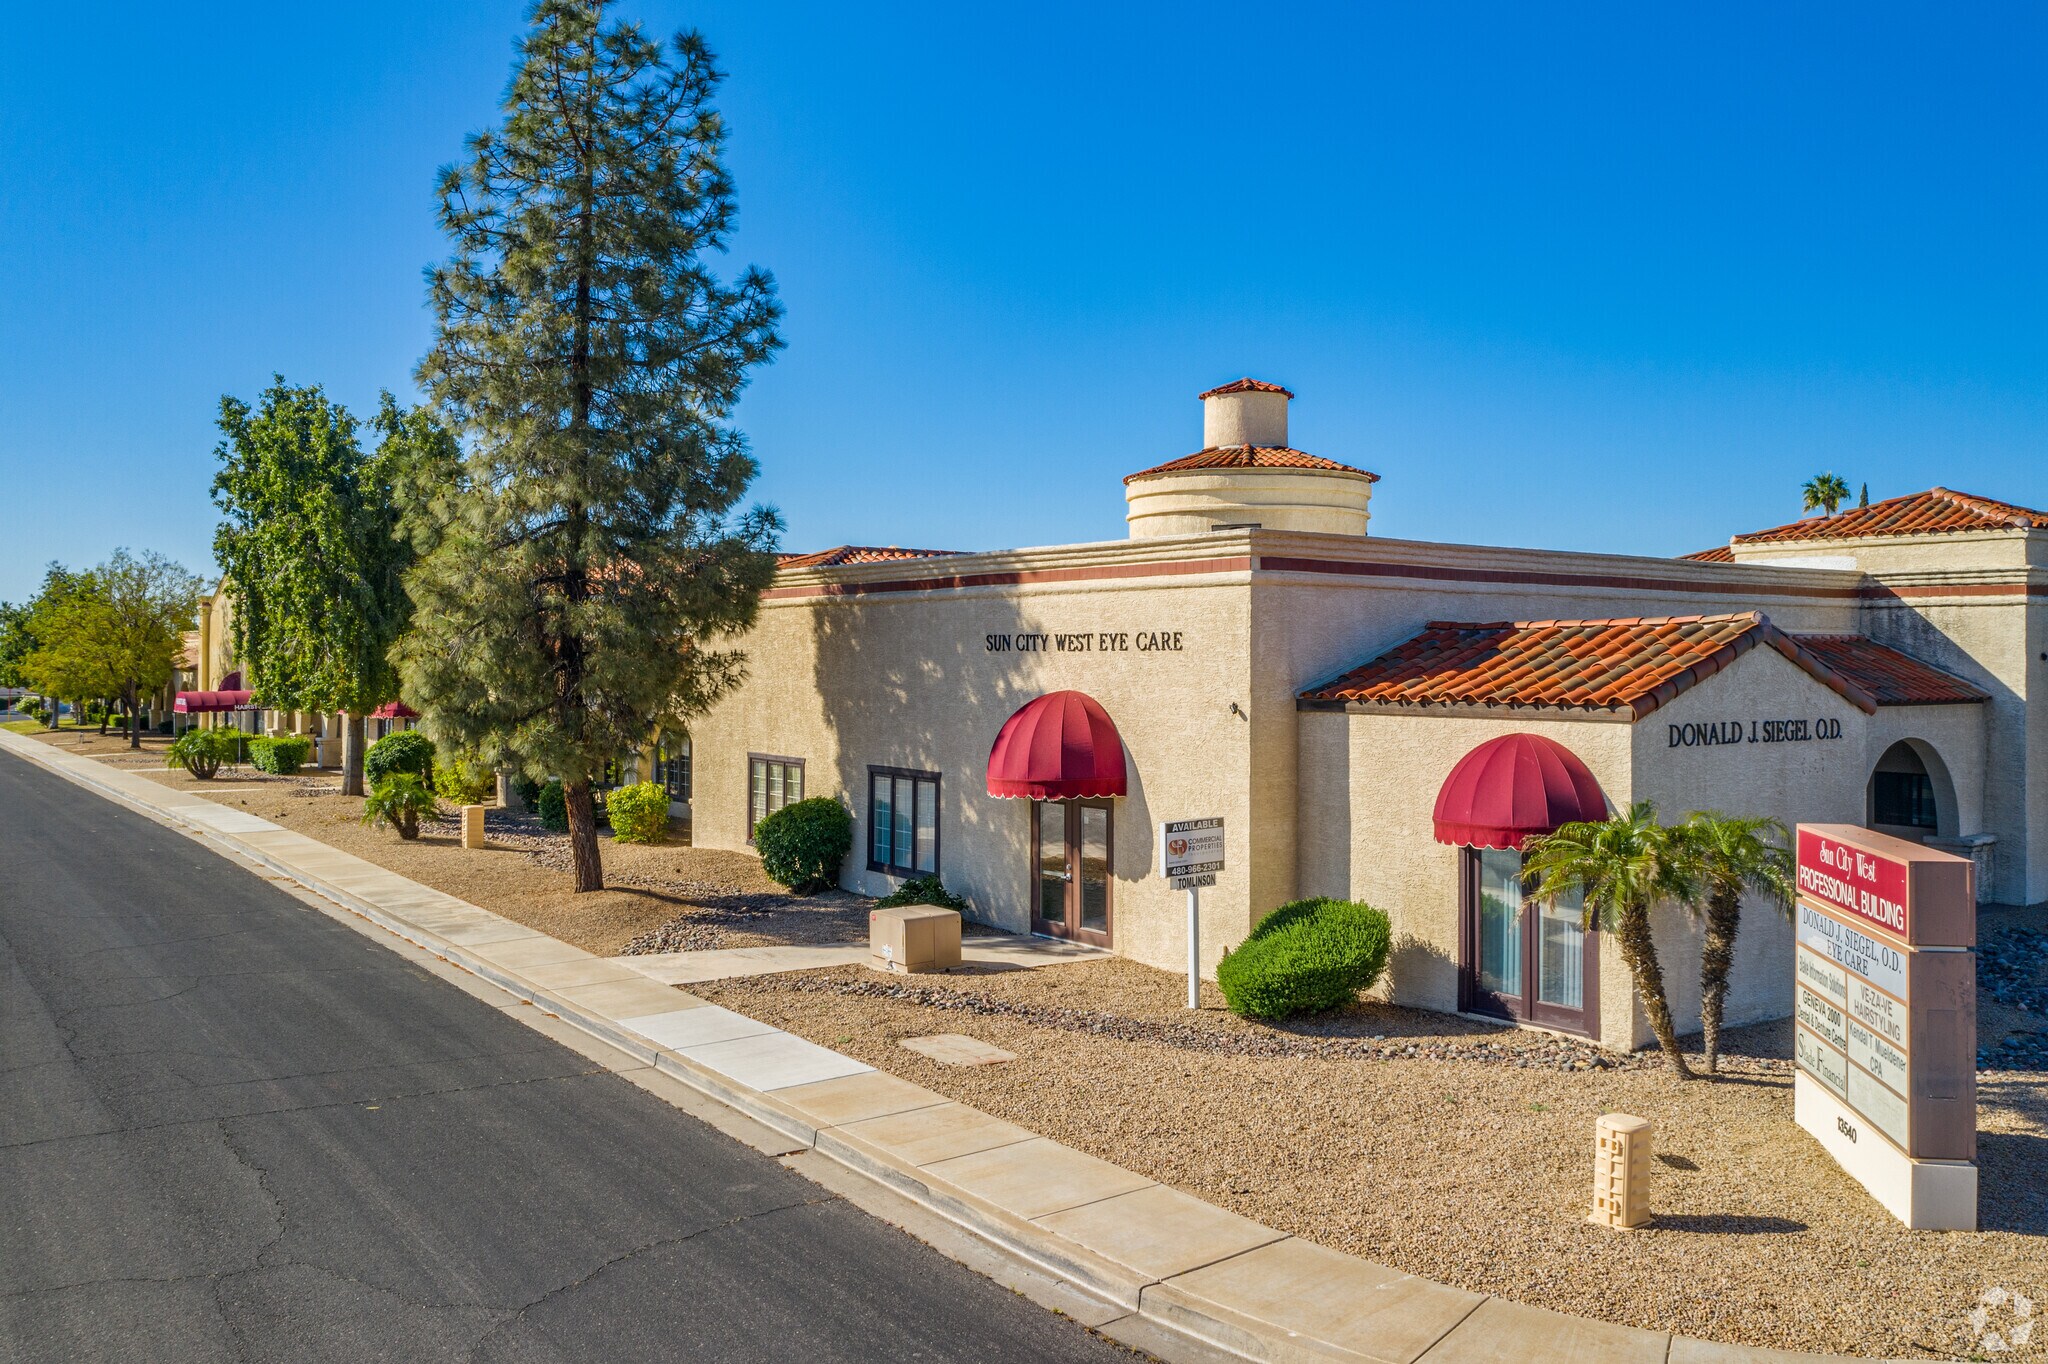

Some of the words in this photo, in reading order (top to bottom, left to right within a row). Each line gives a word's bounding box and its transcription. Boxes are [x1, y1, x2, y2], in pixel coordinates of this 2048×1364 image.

[986, 634, 1011, 651] SUN
[1016, 634, 1049, 651] CITY
[1054, 633, 1093, 651] WEST
[1099, 633, 1128, 651] EYE
[1135, 632, 1183, 651] CARE
[1668, 721, 1743, 748] DONALD
[1748, 721, 1759, 743] J.
[1763, 719, 1811, 743] SIEGEL
[1815, 718, 1843, 740] O.D.
[1172, 820, 1218, 832] AVAILABLE
[1188, 836, 1222, 845] COMMERCIAL
[1188, 842, 1222, 852] PROPERTIES
[1820, 840, 1834, 866] Sun
[1836, 846, 1853, 880] City
[1856, 852, 1876, 882] West
[1178, 873, 1216, 889] TOMLINSON
[1800, 864, 1859, 910] PROFESSIONAL
[1861, 890, 1904, 930] BUILDING
[1803, 907, 1834, 938] DONALD
[1836, 924, 1842, 943] J.
[1845, 928, 1879, 966] SIEGEL,
[1881, 946, 1902, 974] O.D.
[1827, 939, 1842, 961] EYE
[1845, 950, 1868, 976] CARE
[1803, 990, 1826, 1018] GENEVA
[1827, 1007, 1841, 1027] 2000
[1854, 999, 1900, 1041] HAIRSTYLING
[1817, 1045, 1846, 1092] Financial
[1870, 1056, 1883, 1078] CPA
[1837, 1116, 1857, 1144] 13540
